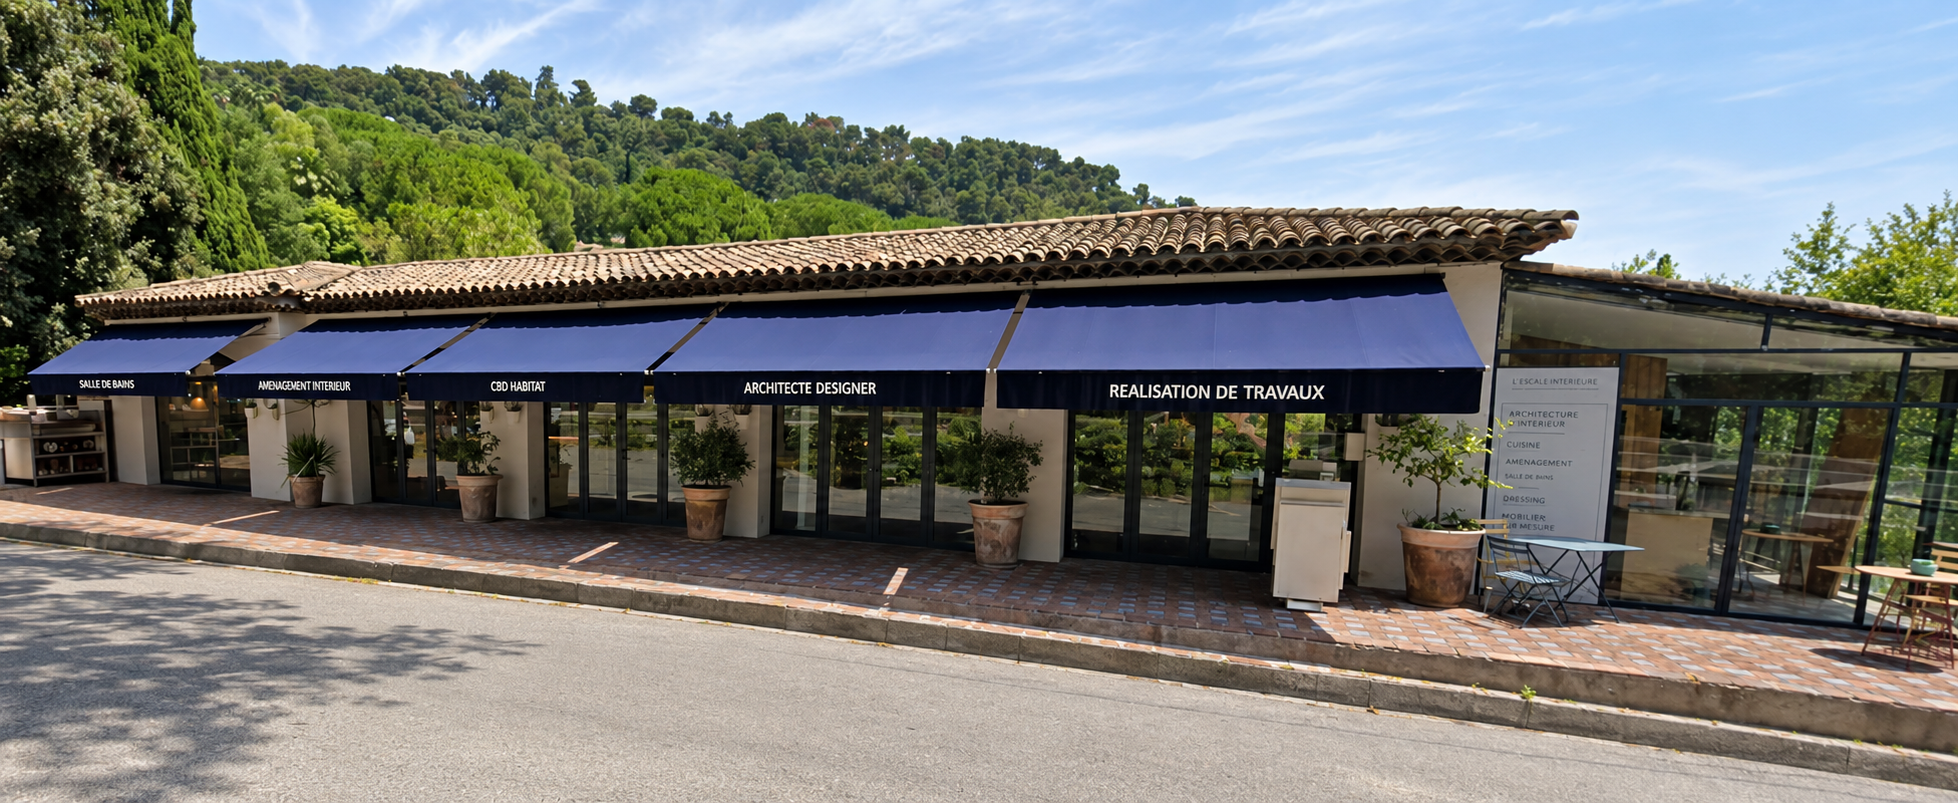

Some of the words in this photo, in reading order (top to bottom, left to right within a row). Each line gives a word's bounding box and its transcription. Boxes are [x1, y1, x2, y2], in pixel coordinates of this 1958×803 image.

[79, 380, 101, 389] SALLE
[102, 380, 112, 389] DE
[112, 380, 135, 389] BAINS
[258, 380, 312, 391] AMENAGEMENT
[312, 381, 351, 391] INTERIEUR
[490, 380, 509, 391] CBD
[510, 381, 546, 392] HABITAT
[1550, 378, 1598, 386] INTERIEURE
[744, 382, 812, 394] ARCHITECTE
[816, 382, 877, 395] DESIGNER
[1109, 384, 1211, 399] REALISATION
[1215, 384, 1239, 400] DE
[1242, 385, 1325, 400] TRAVAUX
[1509, 410, 1579, 419] ARCHITECTURE
[1508, 420, 1565, 428] 'INTERIEUR
[1506, 441, 1541, 449] CUISINE
[1505, 459, 1573, 468] AMENAGEMENT
[1501, 513, 1546, 522] MOBILIER
[1519, 523, 1556, 532] MESURE
